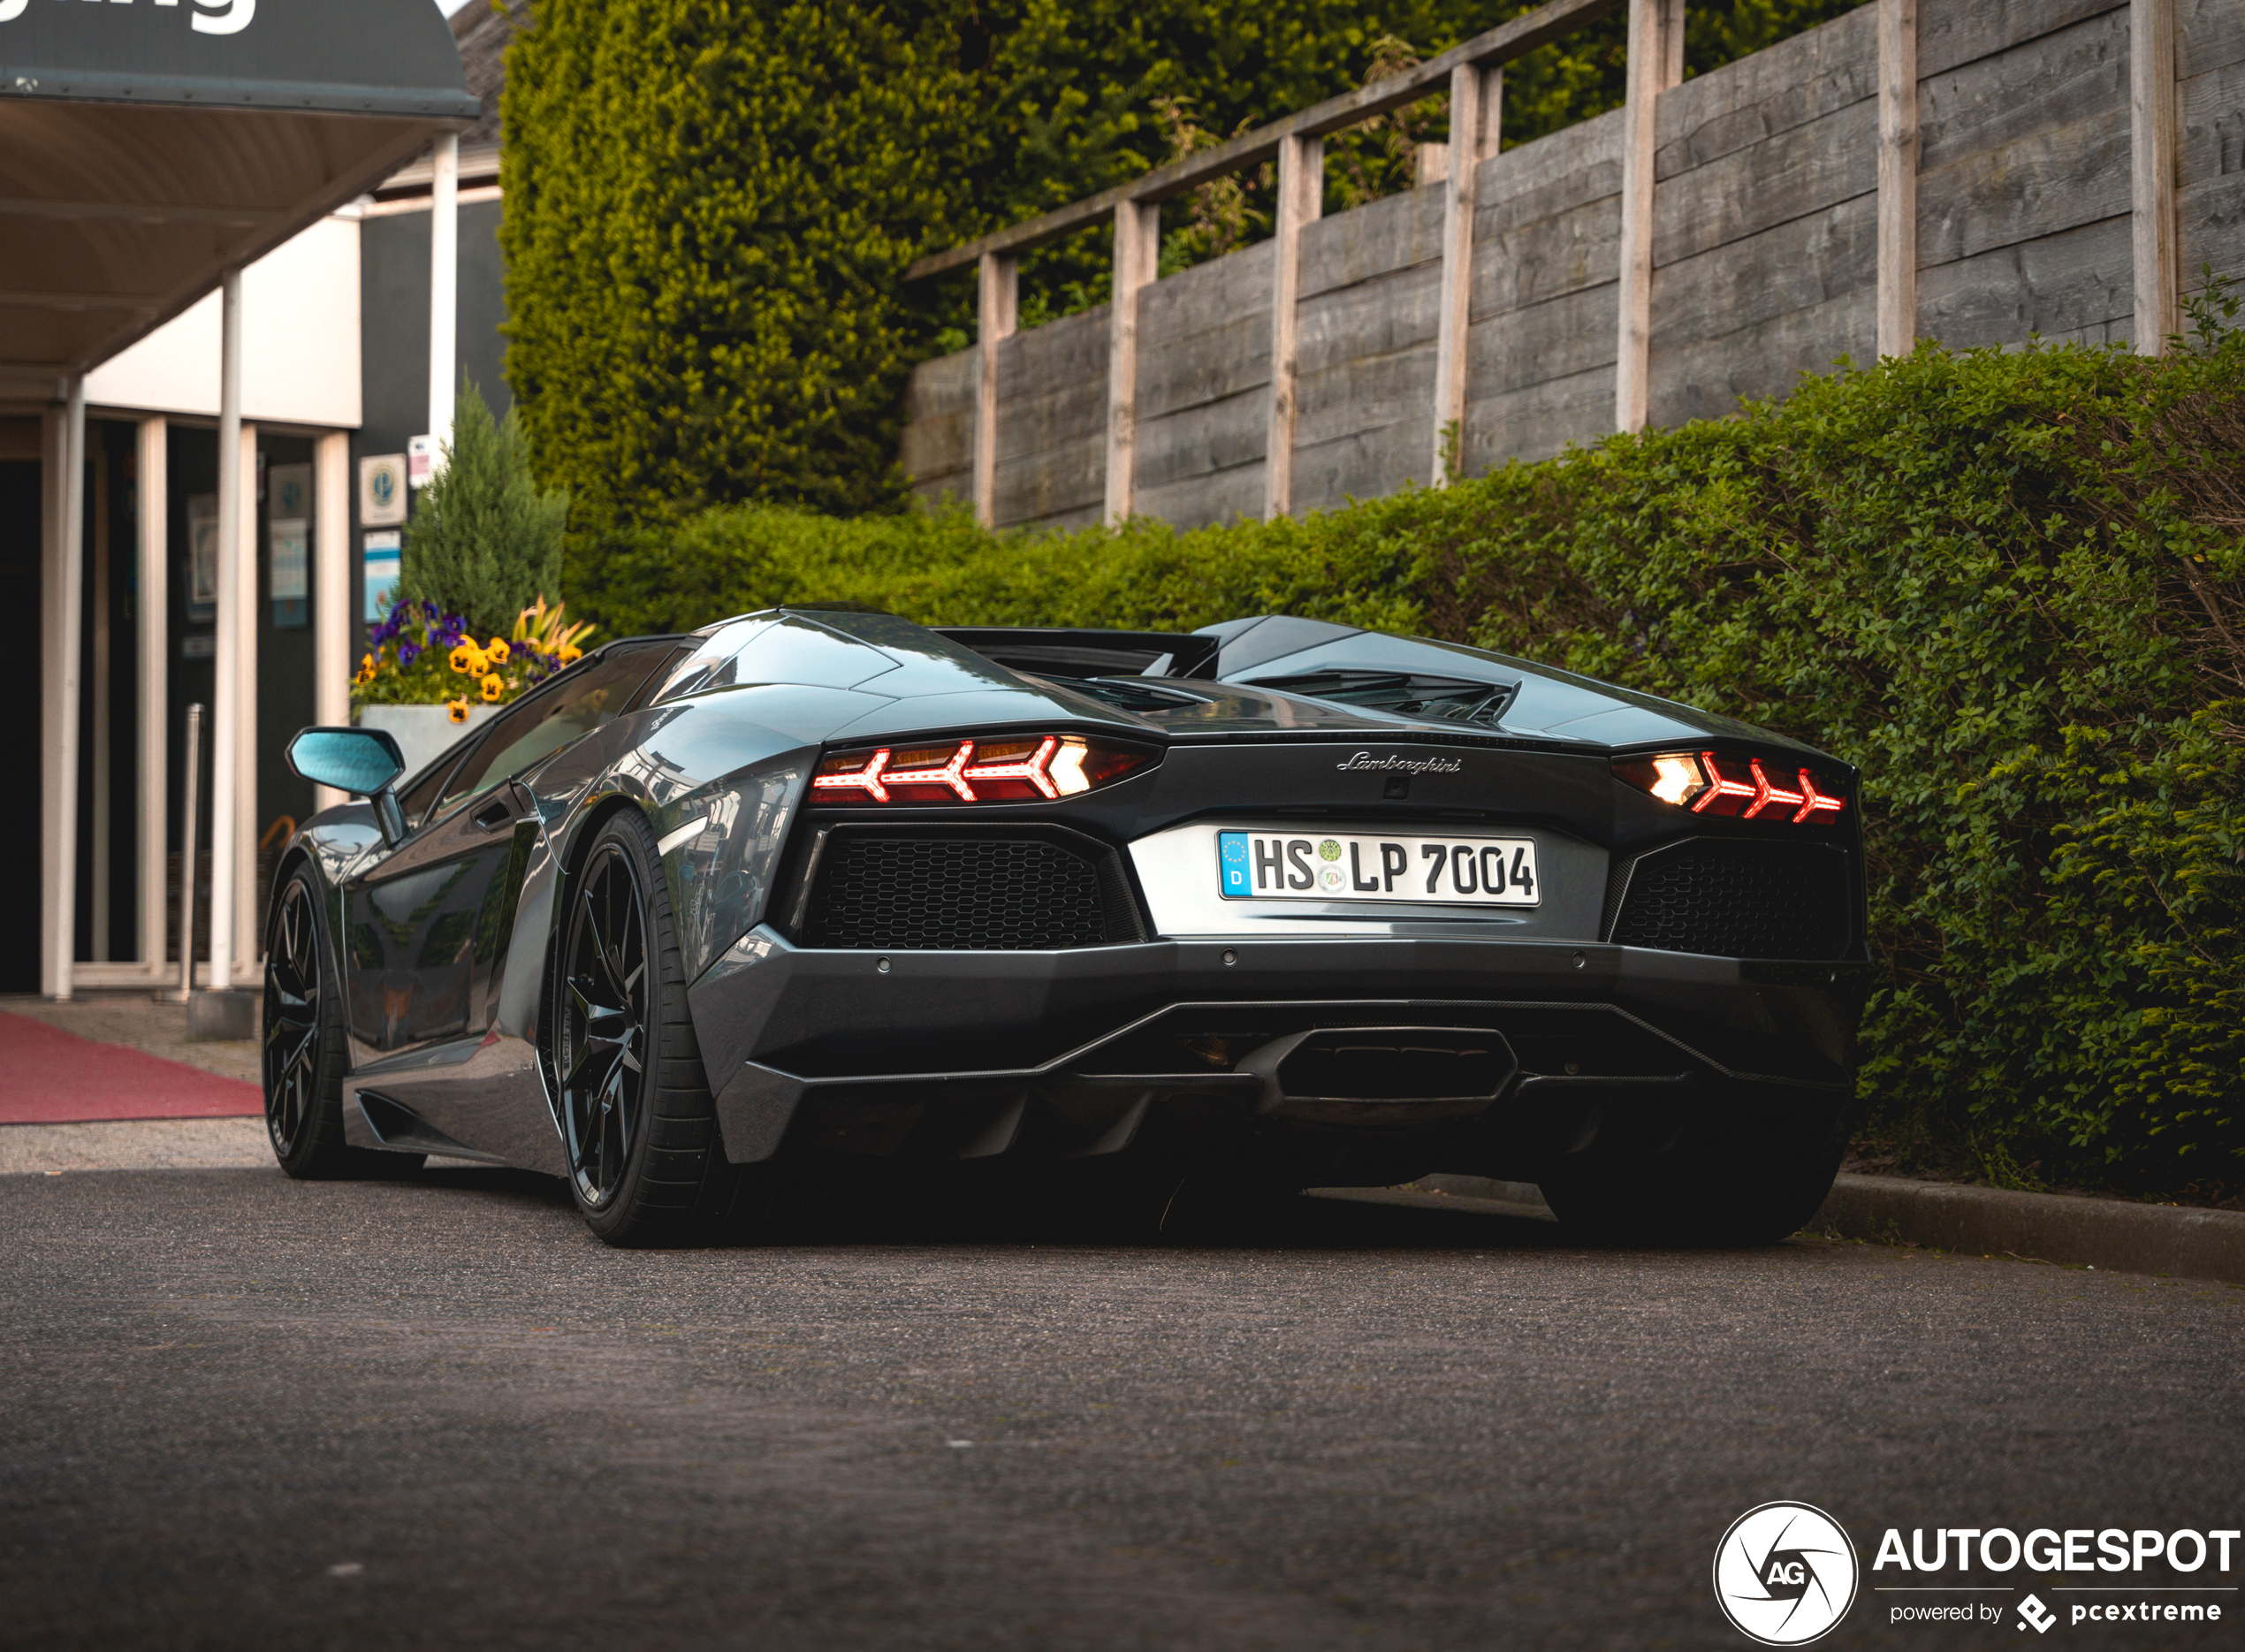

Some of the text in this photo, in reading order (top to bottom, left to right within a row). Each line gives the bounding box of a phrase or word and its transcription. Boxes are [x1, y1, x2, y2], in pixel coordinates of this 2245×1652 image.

[1336, 751, 1462, 775] Lamborghini
[1230, 870, 1243, 886] D
[1254, 840, 1314, 890] HS
[1350, 841, 1407, 892] LP
[1421, 843, 1534, 896] 7004
